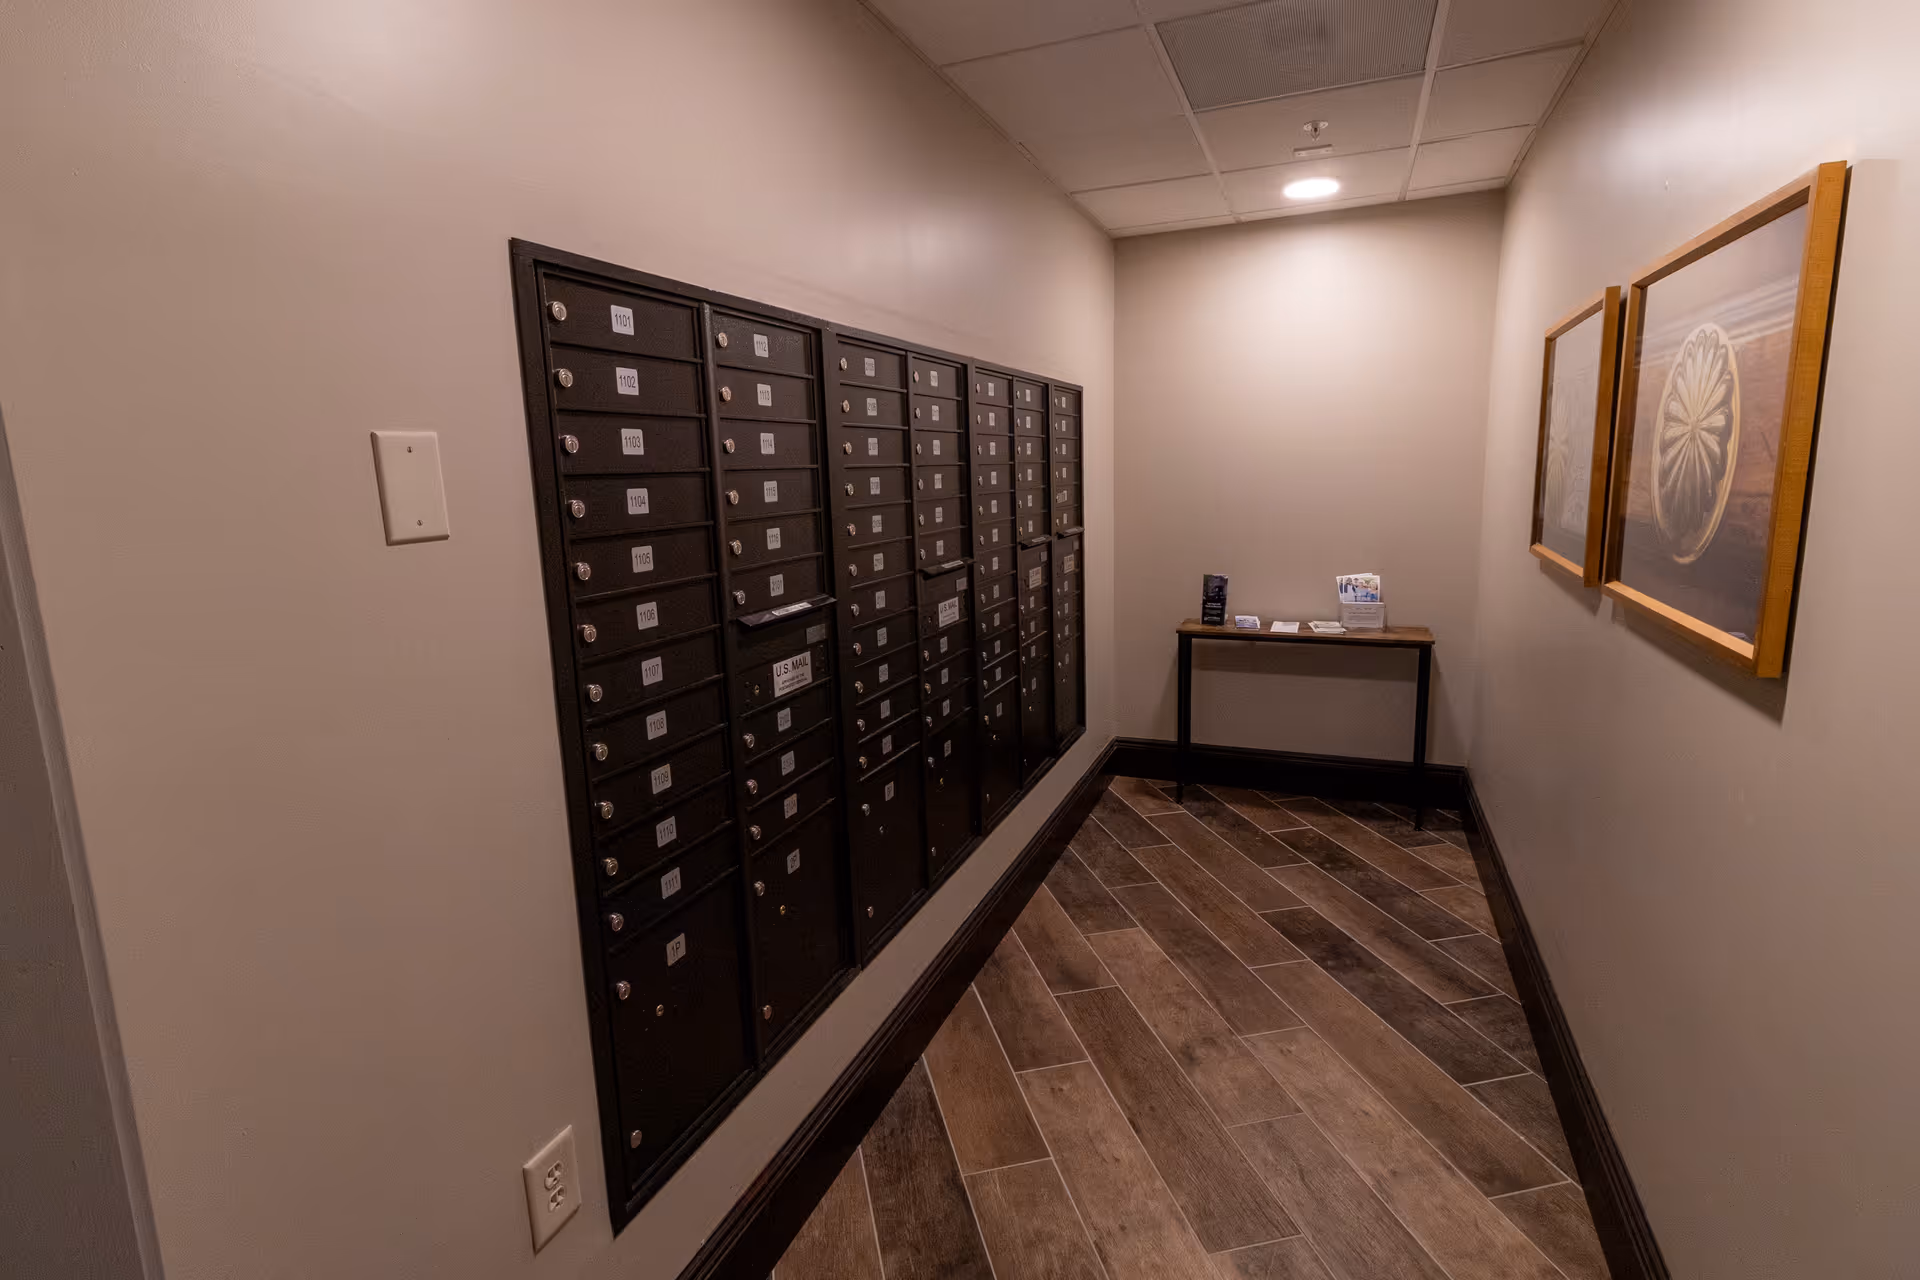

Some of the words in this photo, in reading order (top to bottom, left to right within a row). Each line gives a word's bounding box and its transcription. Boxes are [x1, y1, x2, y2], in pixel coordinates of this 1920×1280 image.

[615, 313, 631, 328] 1101
[619, 374, 636, 389] 1102
[624, 436, 641, 448] 1103
[630, 495, 646, 508] 1104
[635, 552, 650, 567] 1105
[639, 609, 655, 623] 1106
[644, 664, 659, 678] 1107
[776, 663, 791, 677] U.S.
[792, 656, 809, 671] MAIL
[649, 718, 665, 733] 1108
[653, 772, 669, 786] 1109
[659, 824, 673, 841] 1110
[672, 941, 681, 957] 1P
